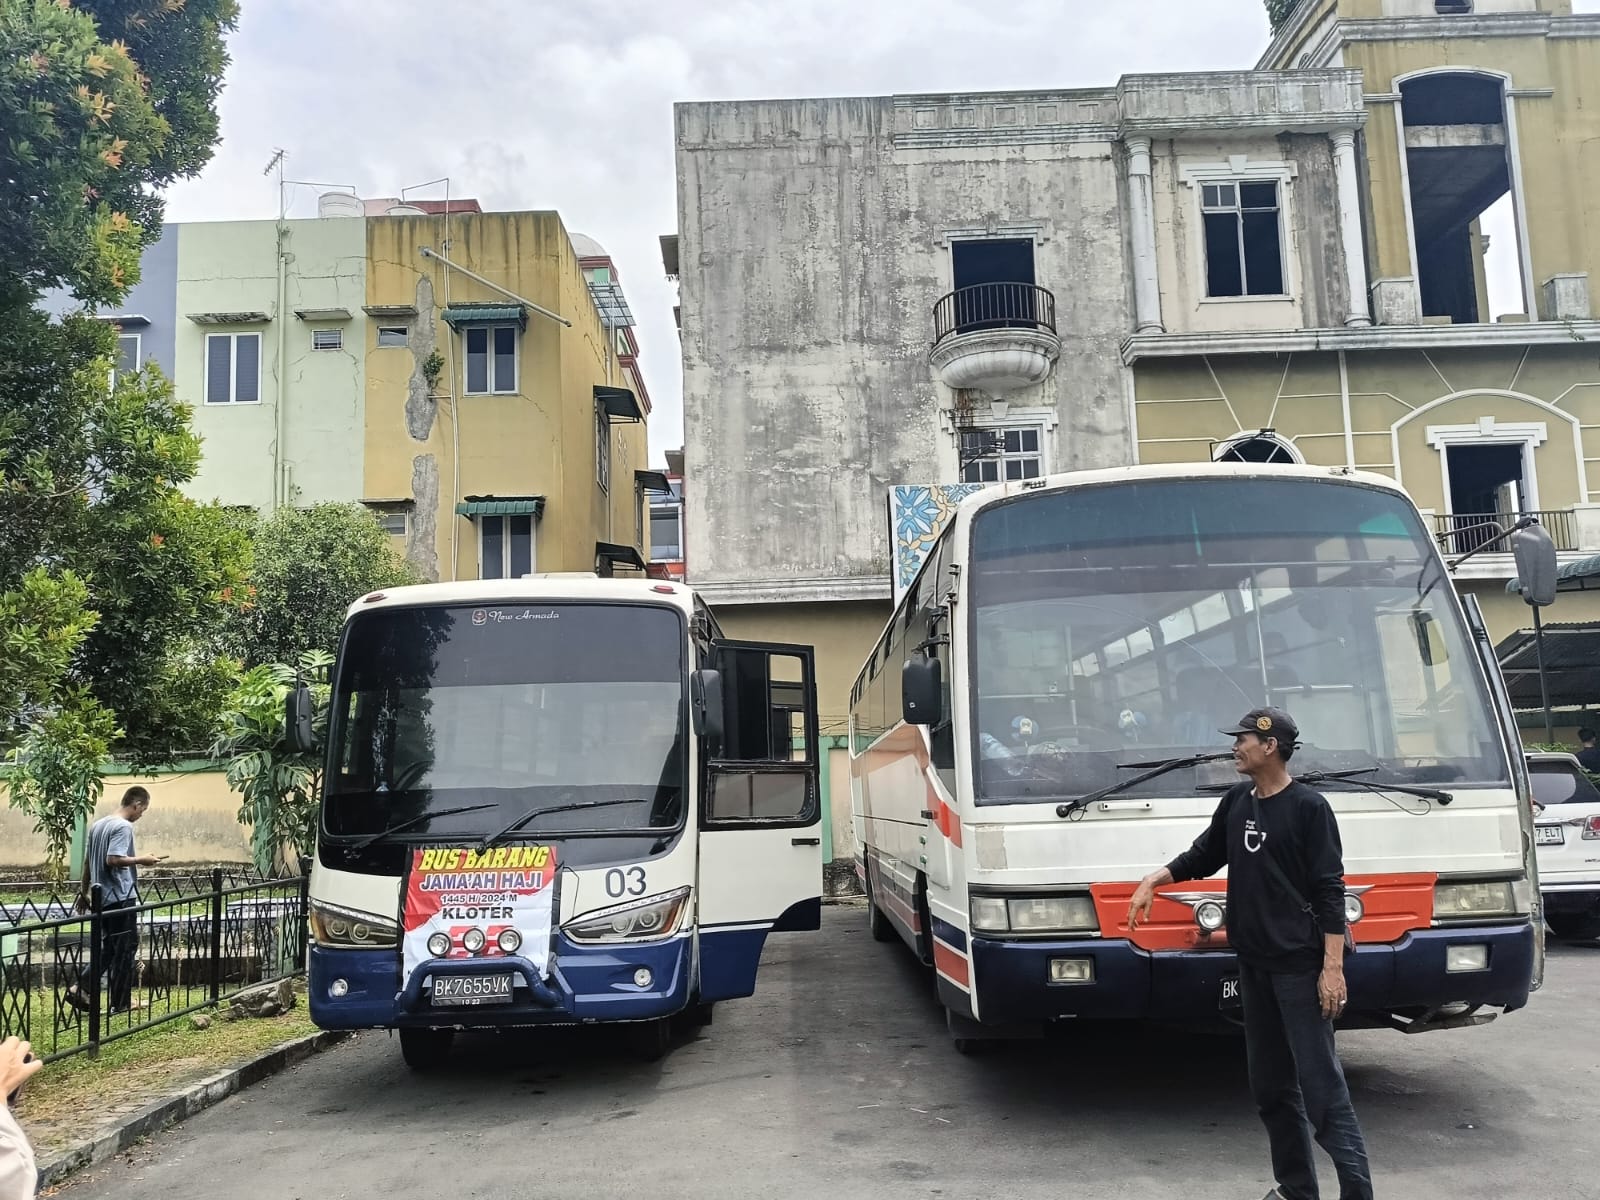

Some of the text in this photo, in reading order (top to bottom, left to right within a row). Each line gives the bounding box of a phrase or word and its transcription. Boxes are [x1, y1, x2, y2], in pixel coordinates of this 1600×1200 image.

[488, 609, 560, 623] New Armada
[1544, 827, 1560, 838] ELT
[418, 846, 550, 871] BUS BARANG
[501, 870, 543, 890] HAJI
[605, 866, 647, 898] 03
[441, 894, 466, 904] 1445
[481, 894, 506, 903] 2024
[442, 906, 514, 920] KLOTER
